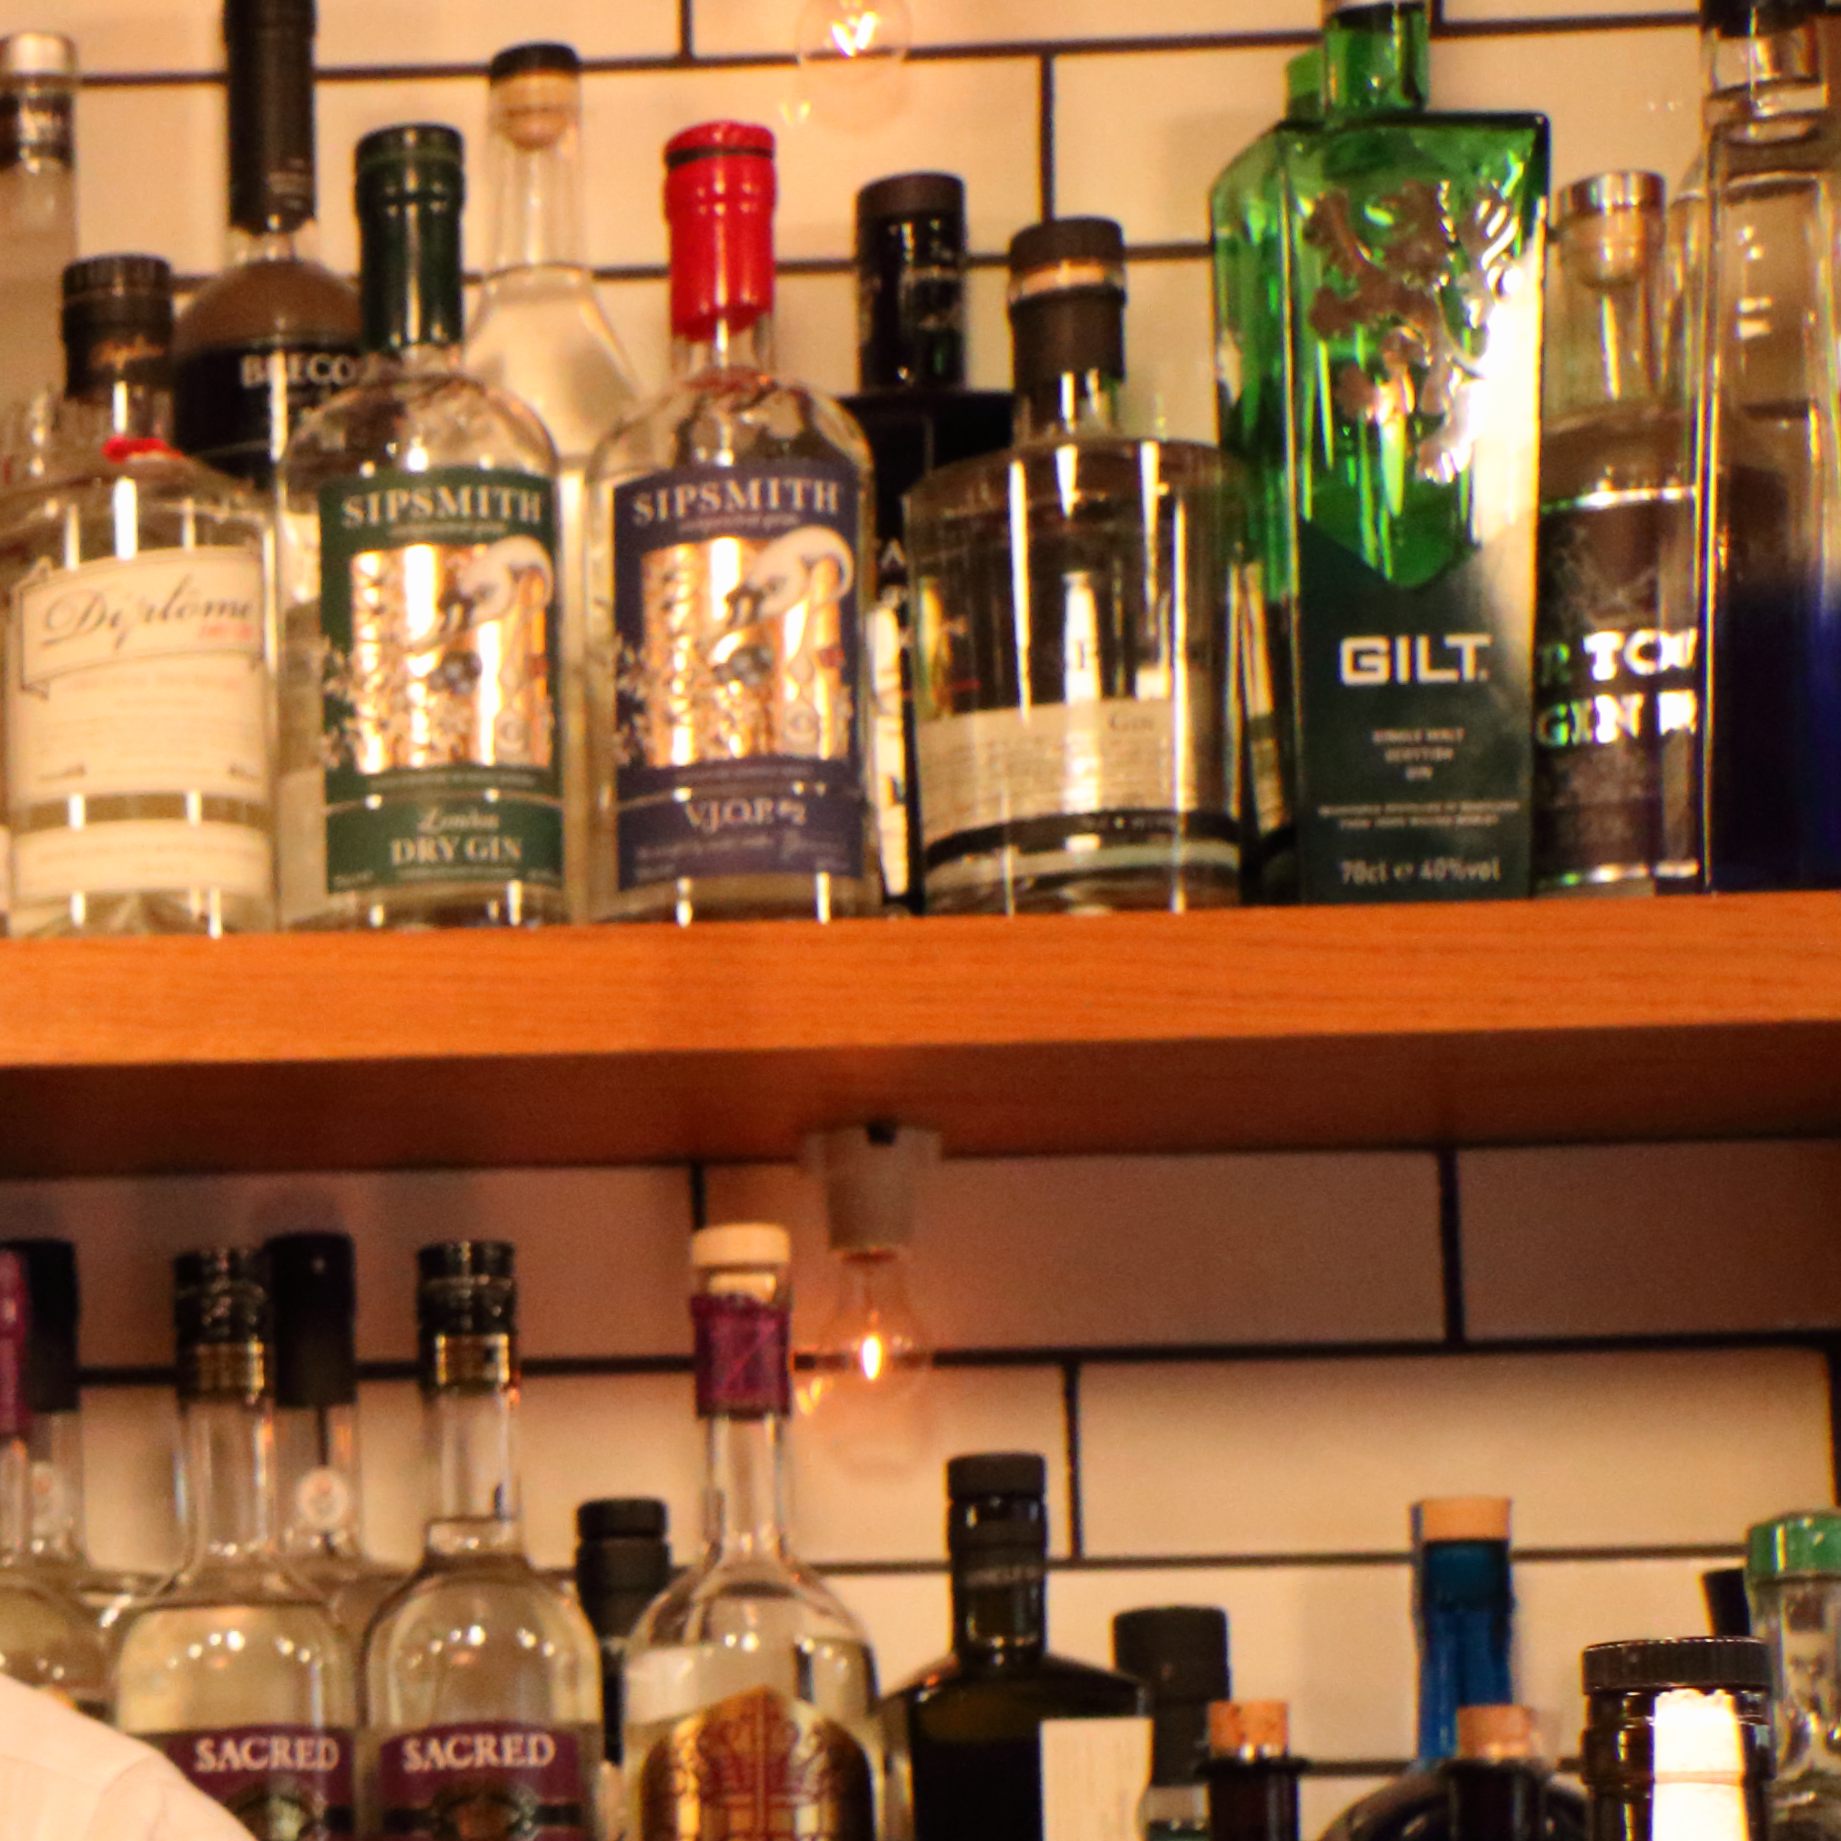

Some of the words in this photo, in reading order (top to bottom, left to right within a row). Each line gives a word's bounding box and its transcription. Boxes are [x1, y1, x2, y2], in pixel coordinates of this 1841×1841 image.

[341, 484, 543, 530] SIPSMITH
[630, 476, 840, 527] SIPSMITH
[418, 806, 500, 834] London
[392, 836, 459, 865] DRY
[466, 835, 523, 862] GIN
[194, 1736, 340, 1773] SACRED
[402, 1732, 557, 1773] SACRED
